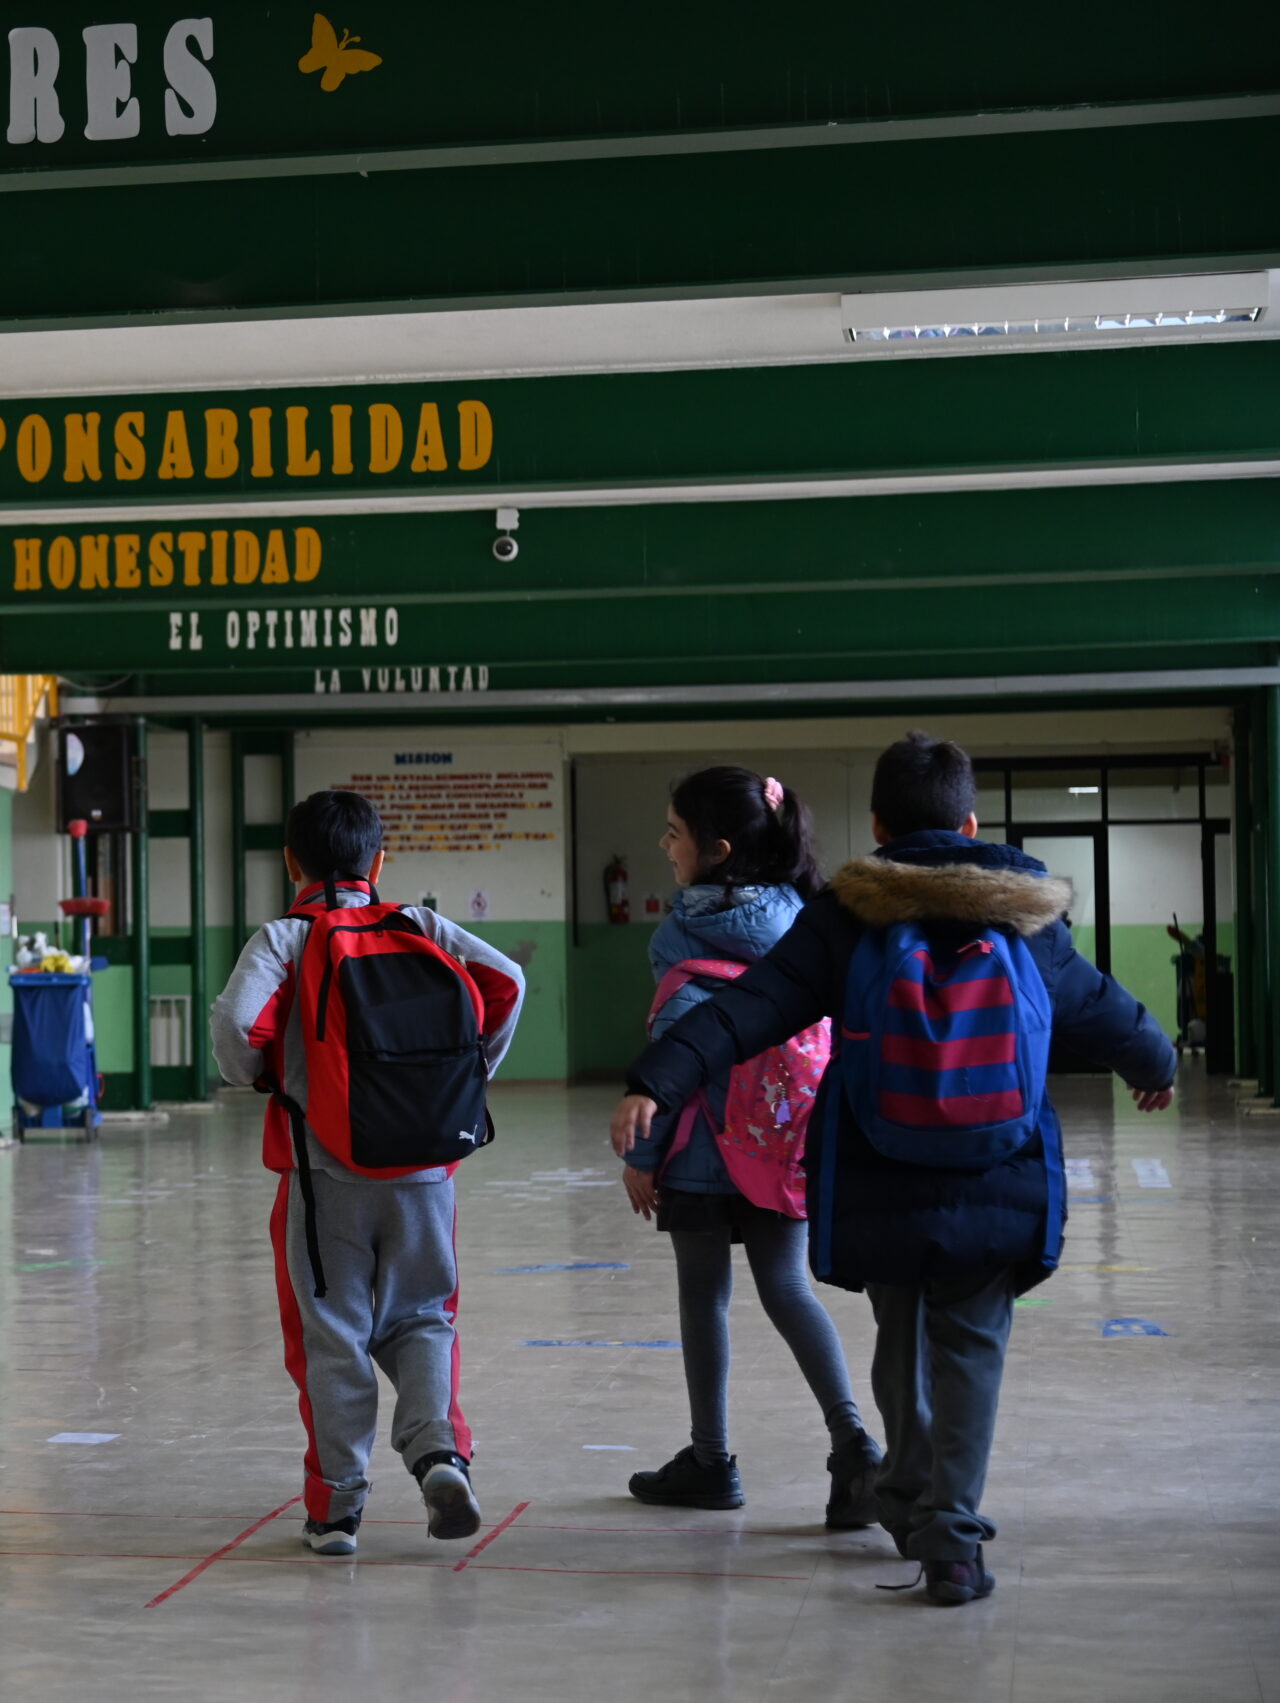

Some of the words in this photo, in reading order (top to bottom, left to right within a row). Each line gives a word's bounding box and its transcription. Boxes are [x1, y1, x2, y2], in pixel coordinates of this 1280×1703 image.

[13, 527, 322, 591] HONESTIDAD
[169, 612, 203, 651] EL
[226, 607, 399, 649] OPTIMISMO
[314, 668, 341, 692] LA
[362, 665, 489, 692] VOLUNTAD
